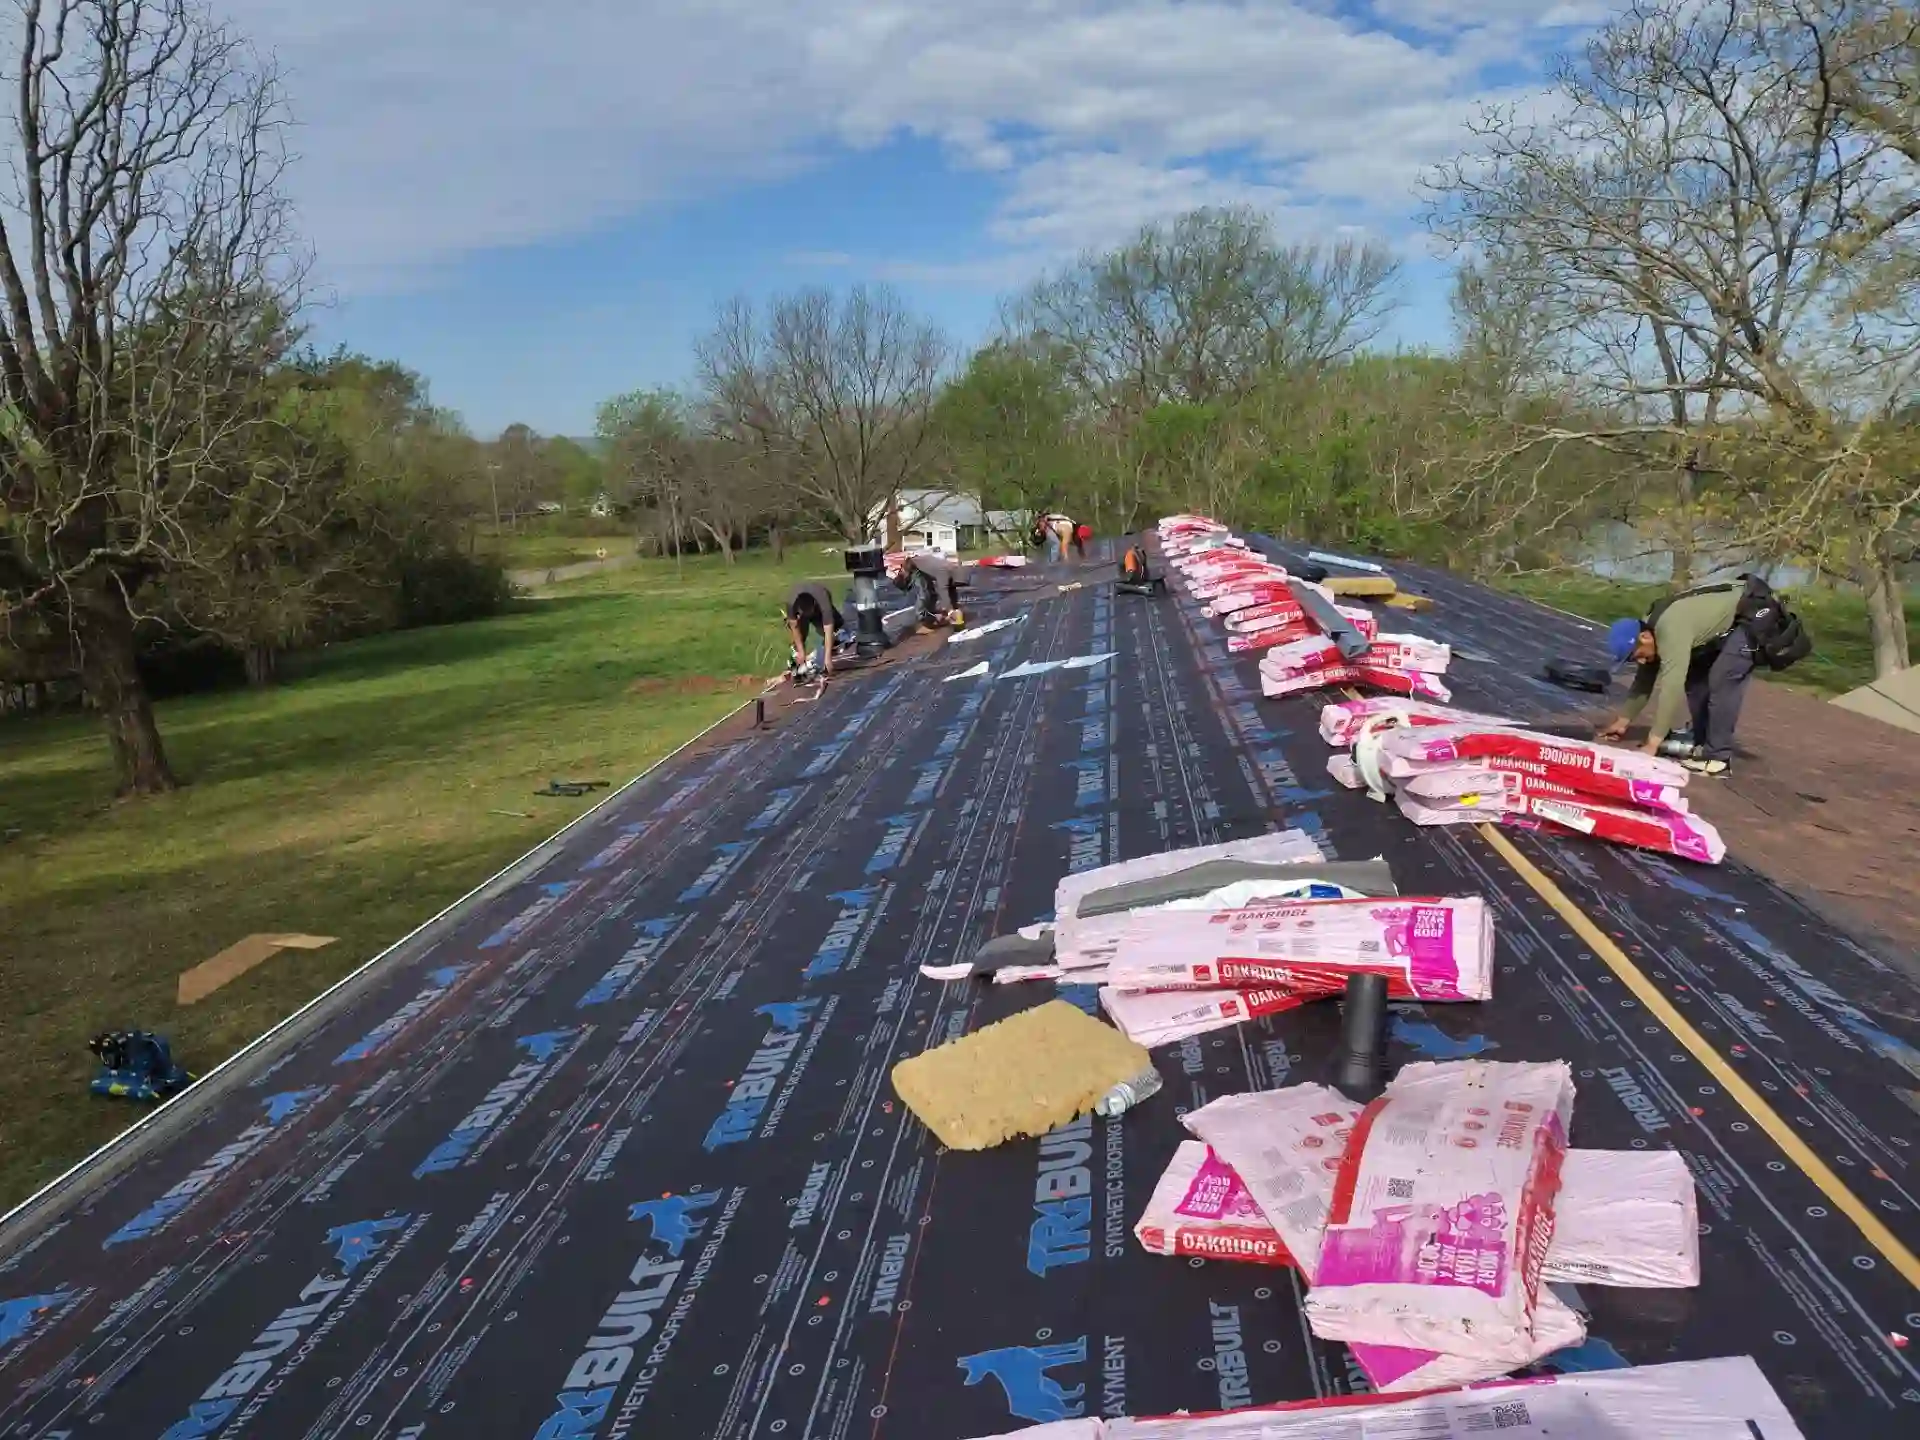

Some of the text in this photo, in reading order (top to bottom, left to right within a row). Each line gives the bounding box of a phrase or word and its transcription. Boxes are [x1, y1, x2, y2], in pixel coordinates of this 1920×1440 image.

[1540, 746, 1591, 769] OAKRIDGE
[1236, 908, 1310, 921] OAKRIDGE
[1106, 1122, 1124, 1179] ROOFING
[1105, 1180, 1124, 1258] SYNTHETIC
[1182, 1232, 1278, 1256] OAKRIDGE
[646, 1291, 697, 1365] ROOFING
[687, 1186, 748, 1290] UNDERLAYMENT
[868, 1231, 911, 1317] TRIBUILT
[276, 1308, 346, 1376] ROOFING
